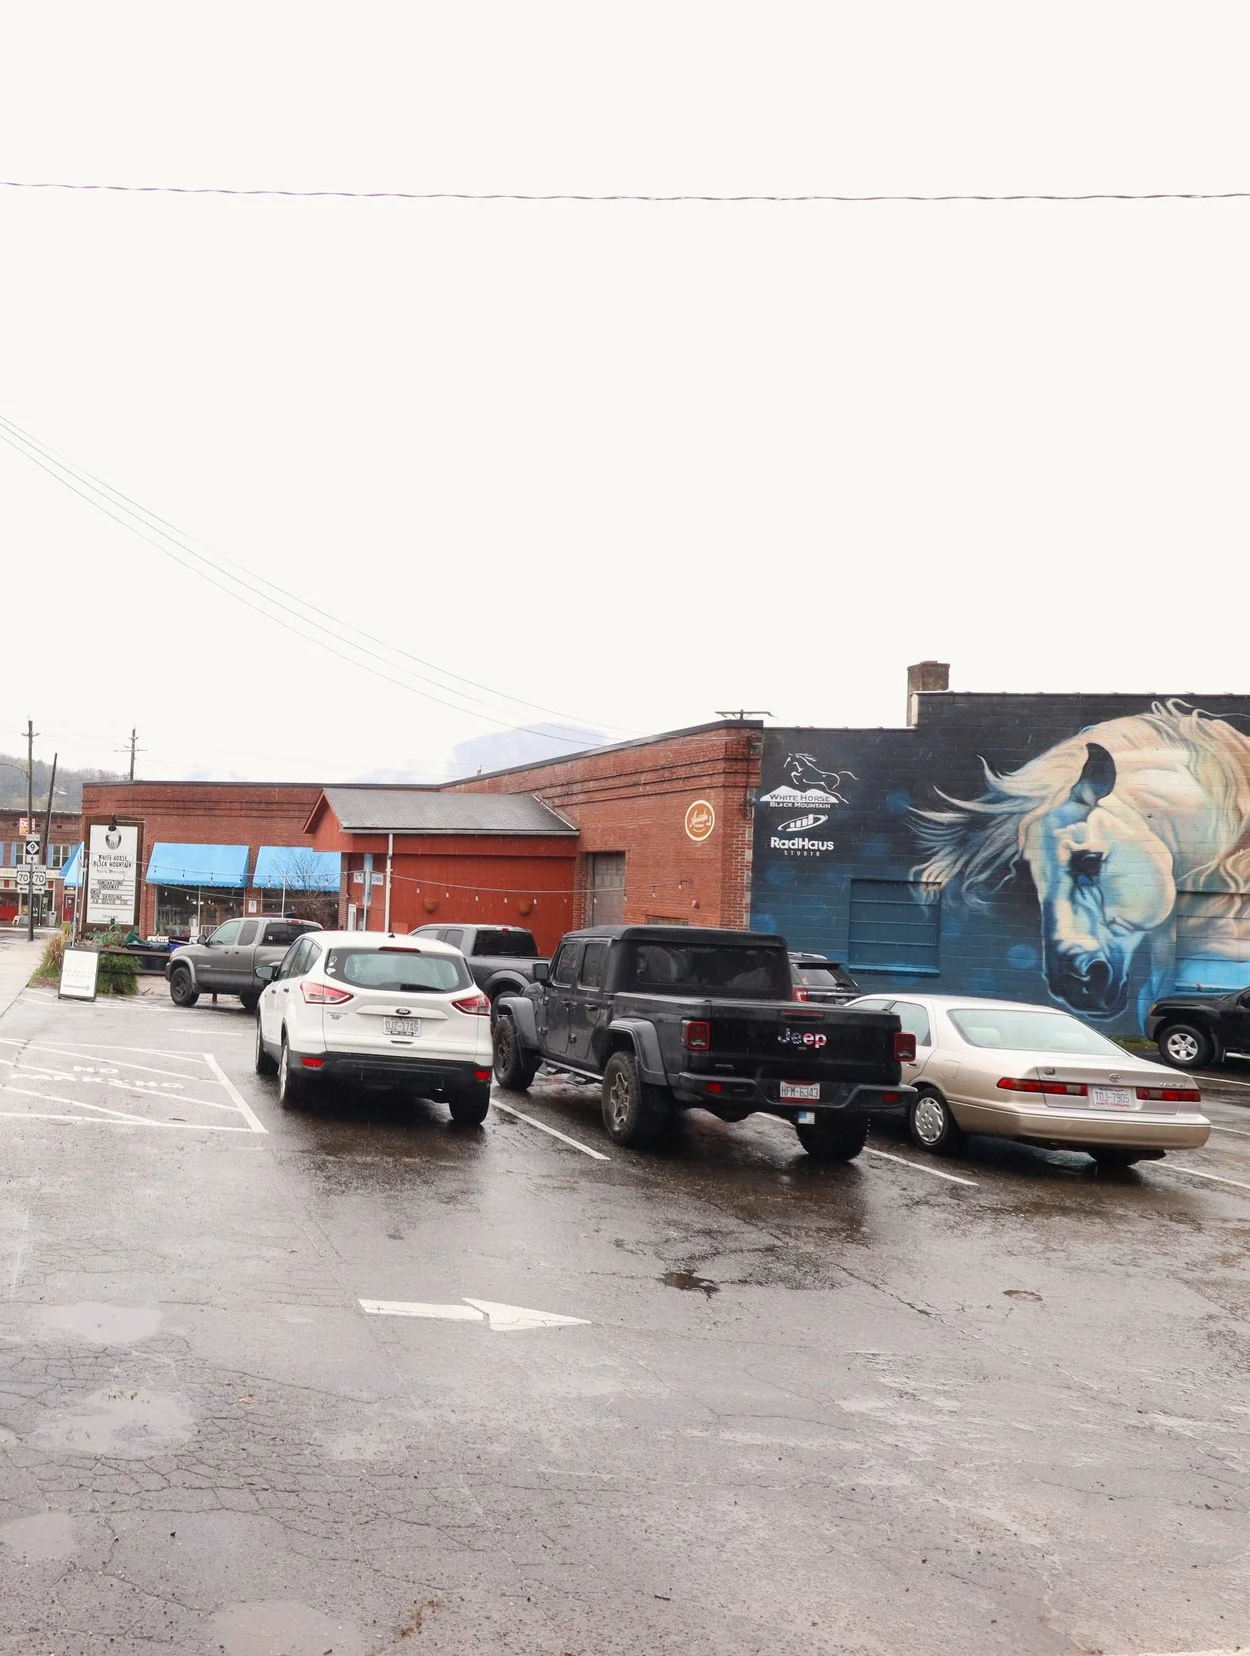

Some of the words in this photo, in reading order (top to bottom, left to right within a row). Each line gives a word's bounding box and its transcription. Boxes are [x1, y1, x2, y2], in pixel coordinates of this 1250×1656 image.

[30, 843, 35, 851] 9
[770, 836, 834, 850] RadHaus
[18, 874, 29, 882] 70
[34, 875, 45, 883] 70
[778, 1027, 827, 1048] Jeep
[73, 1065, 119, 1074] NO
[10, 1073, 184, 1089] PARKING
[781, 1086, 819, 1098] HFM-6343
